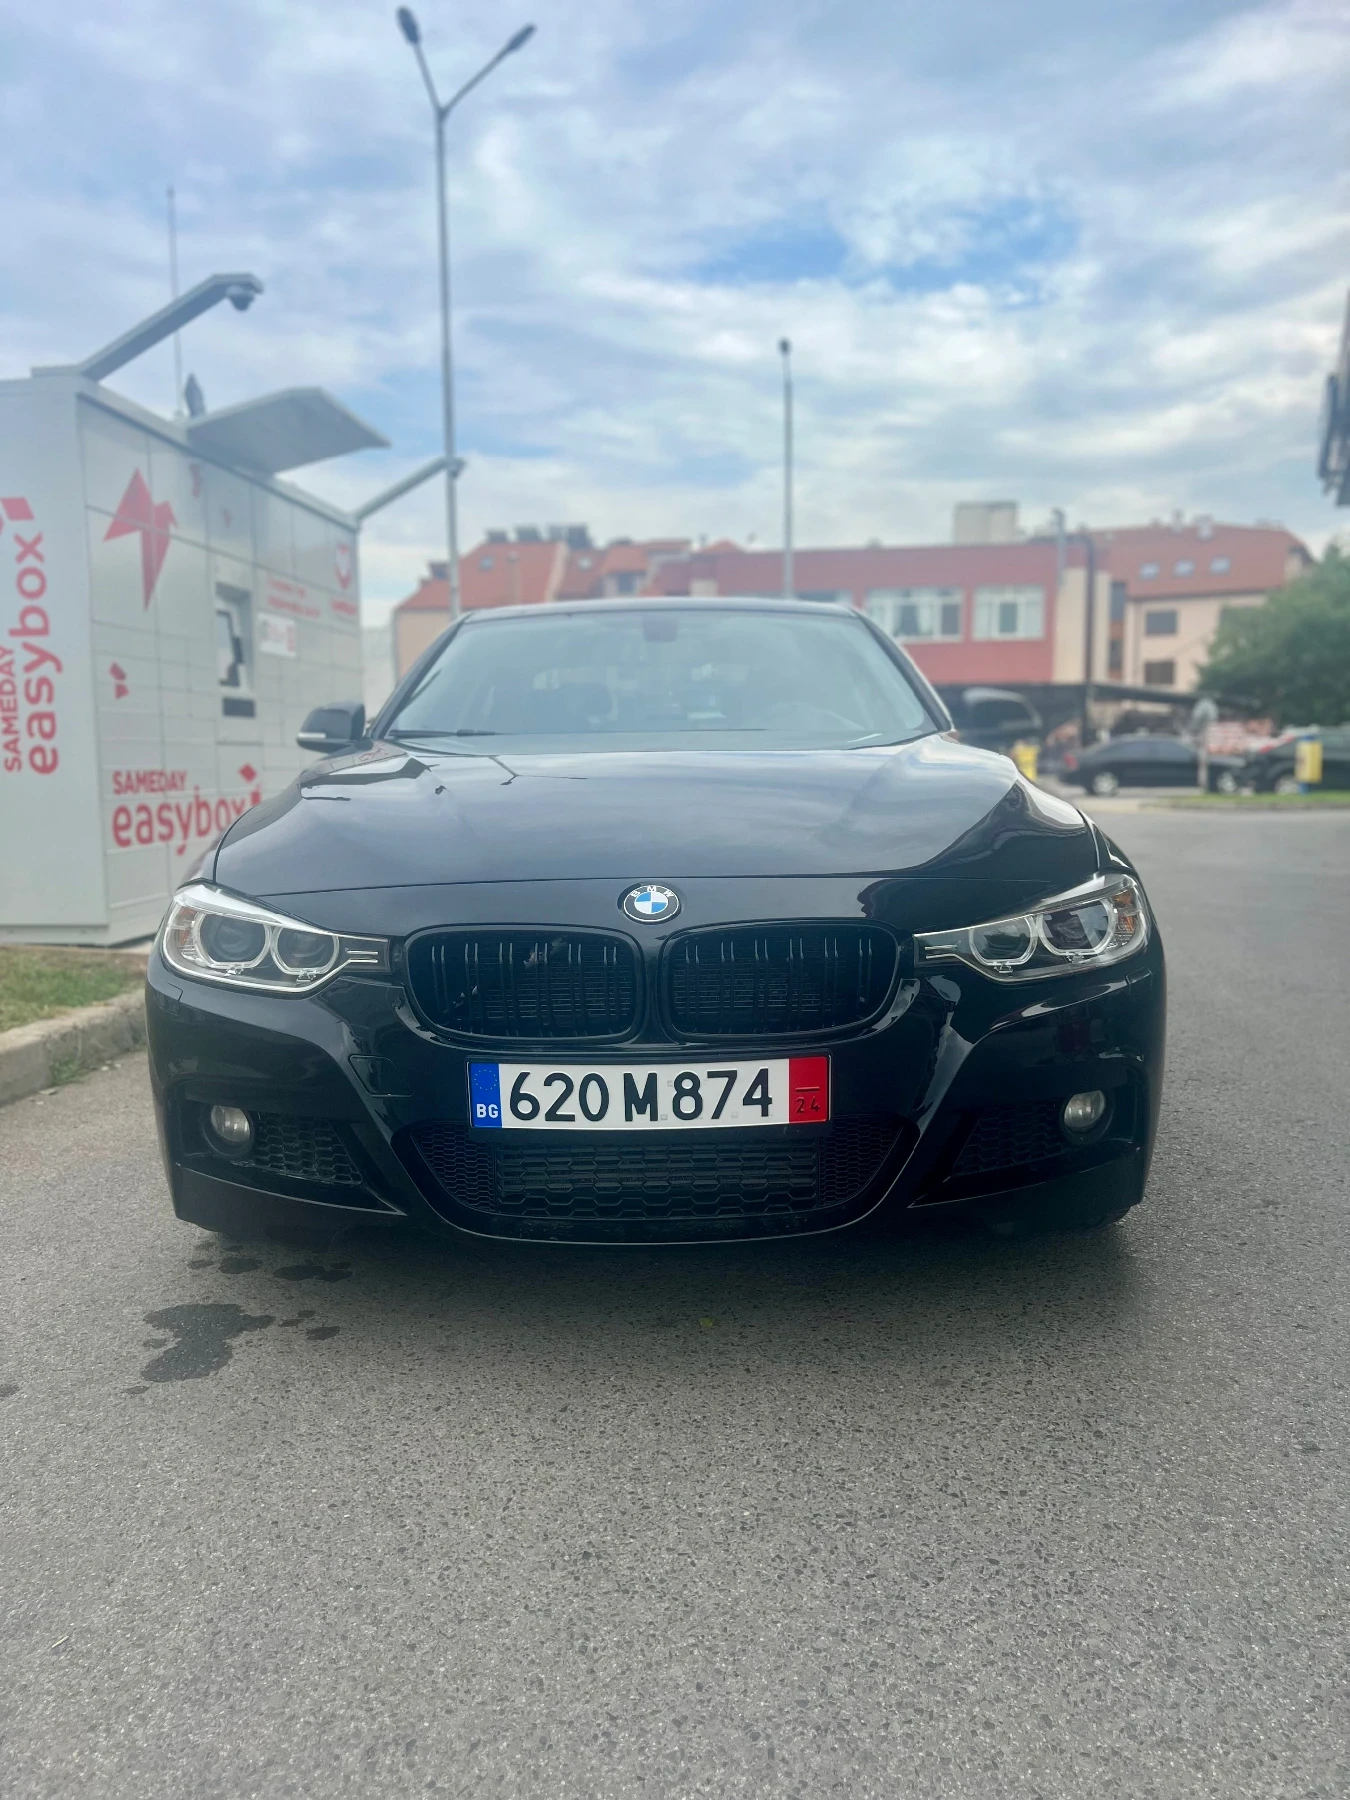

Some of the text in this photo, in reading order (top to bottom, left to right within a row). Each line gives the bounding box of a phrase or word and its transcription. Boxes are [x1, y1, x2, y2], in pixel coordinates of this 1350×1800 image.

[8, 531, 63, 776] easybox
[0, 646, 22, 773] SAMEDAY
[112, 770, 187, 795] SAMEDAY
[630, 885, 675, 898] BMW
[509, 1068, 773, 1122] 620 M 874
[795, 1096, 821, 1114] 24
[476, 1103, 499, 1118] BG
